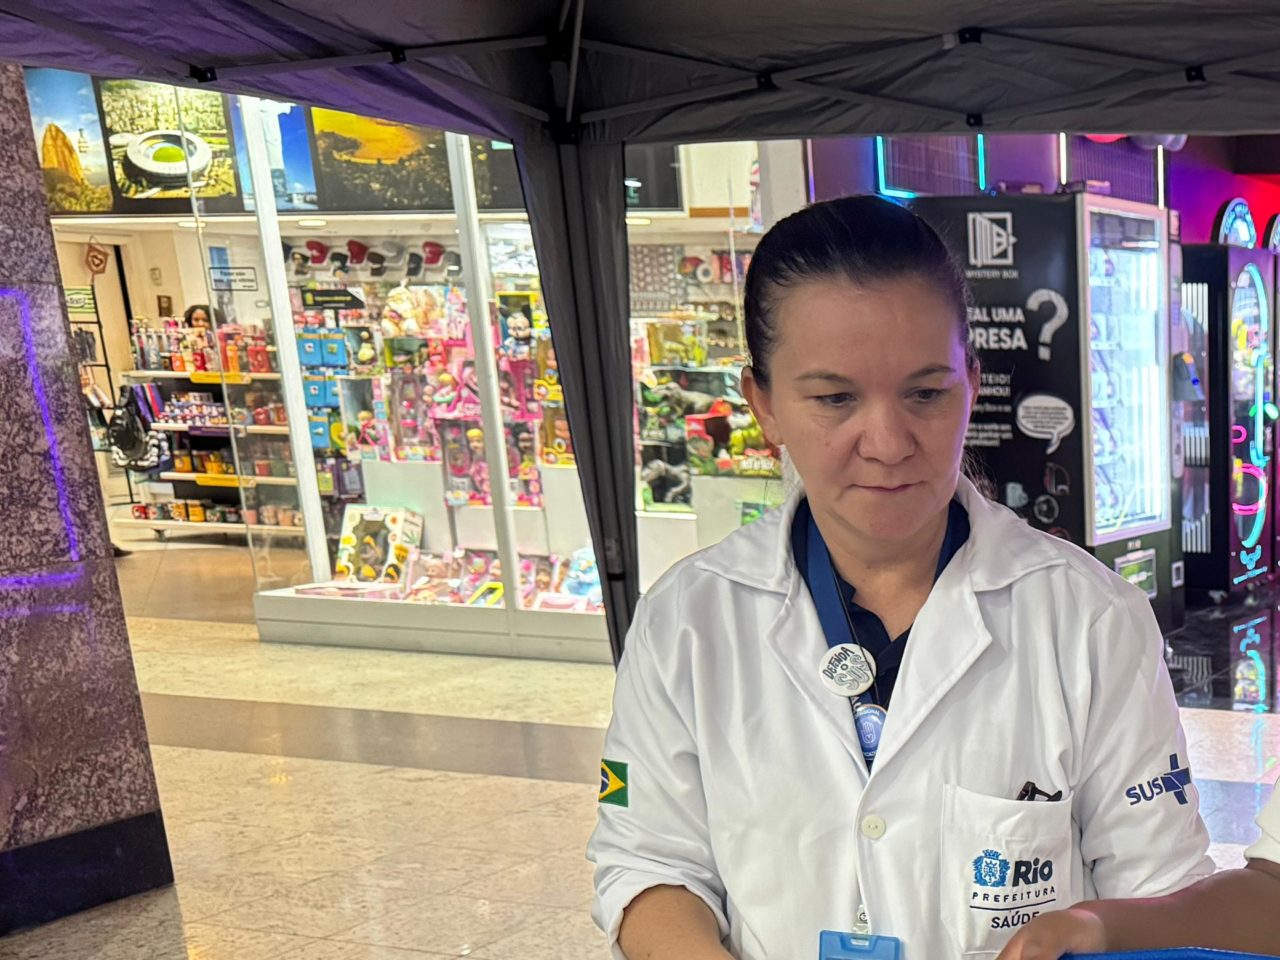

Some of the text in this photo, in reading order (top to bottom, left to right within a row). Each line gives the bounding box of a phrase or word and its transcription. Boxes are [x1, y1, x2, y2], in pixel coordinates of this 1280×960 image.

[1126, 782, 1163, 806] SUS
[1012, 857, 1053, 887] Rio
[972, 886, 1055, 903] PREFEITURA
